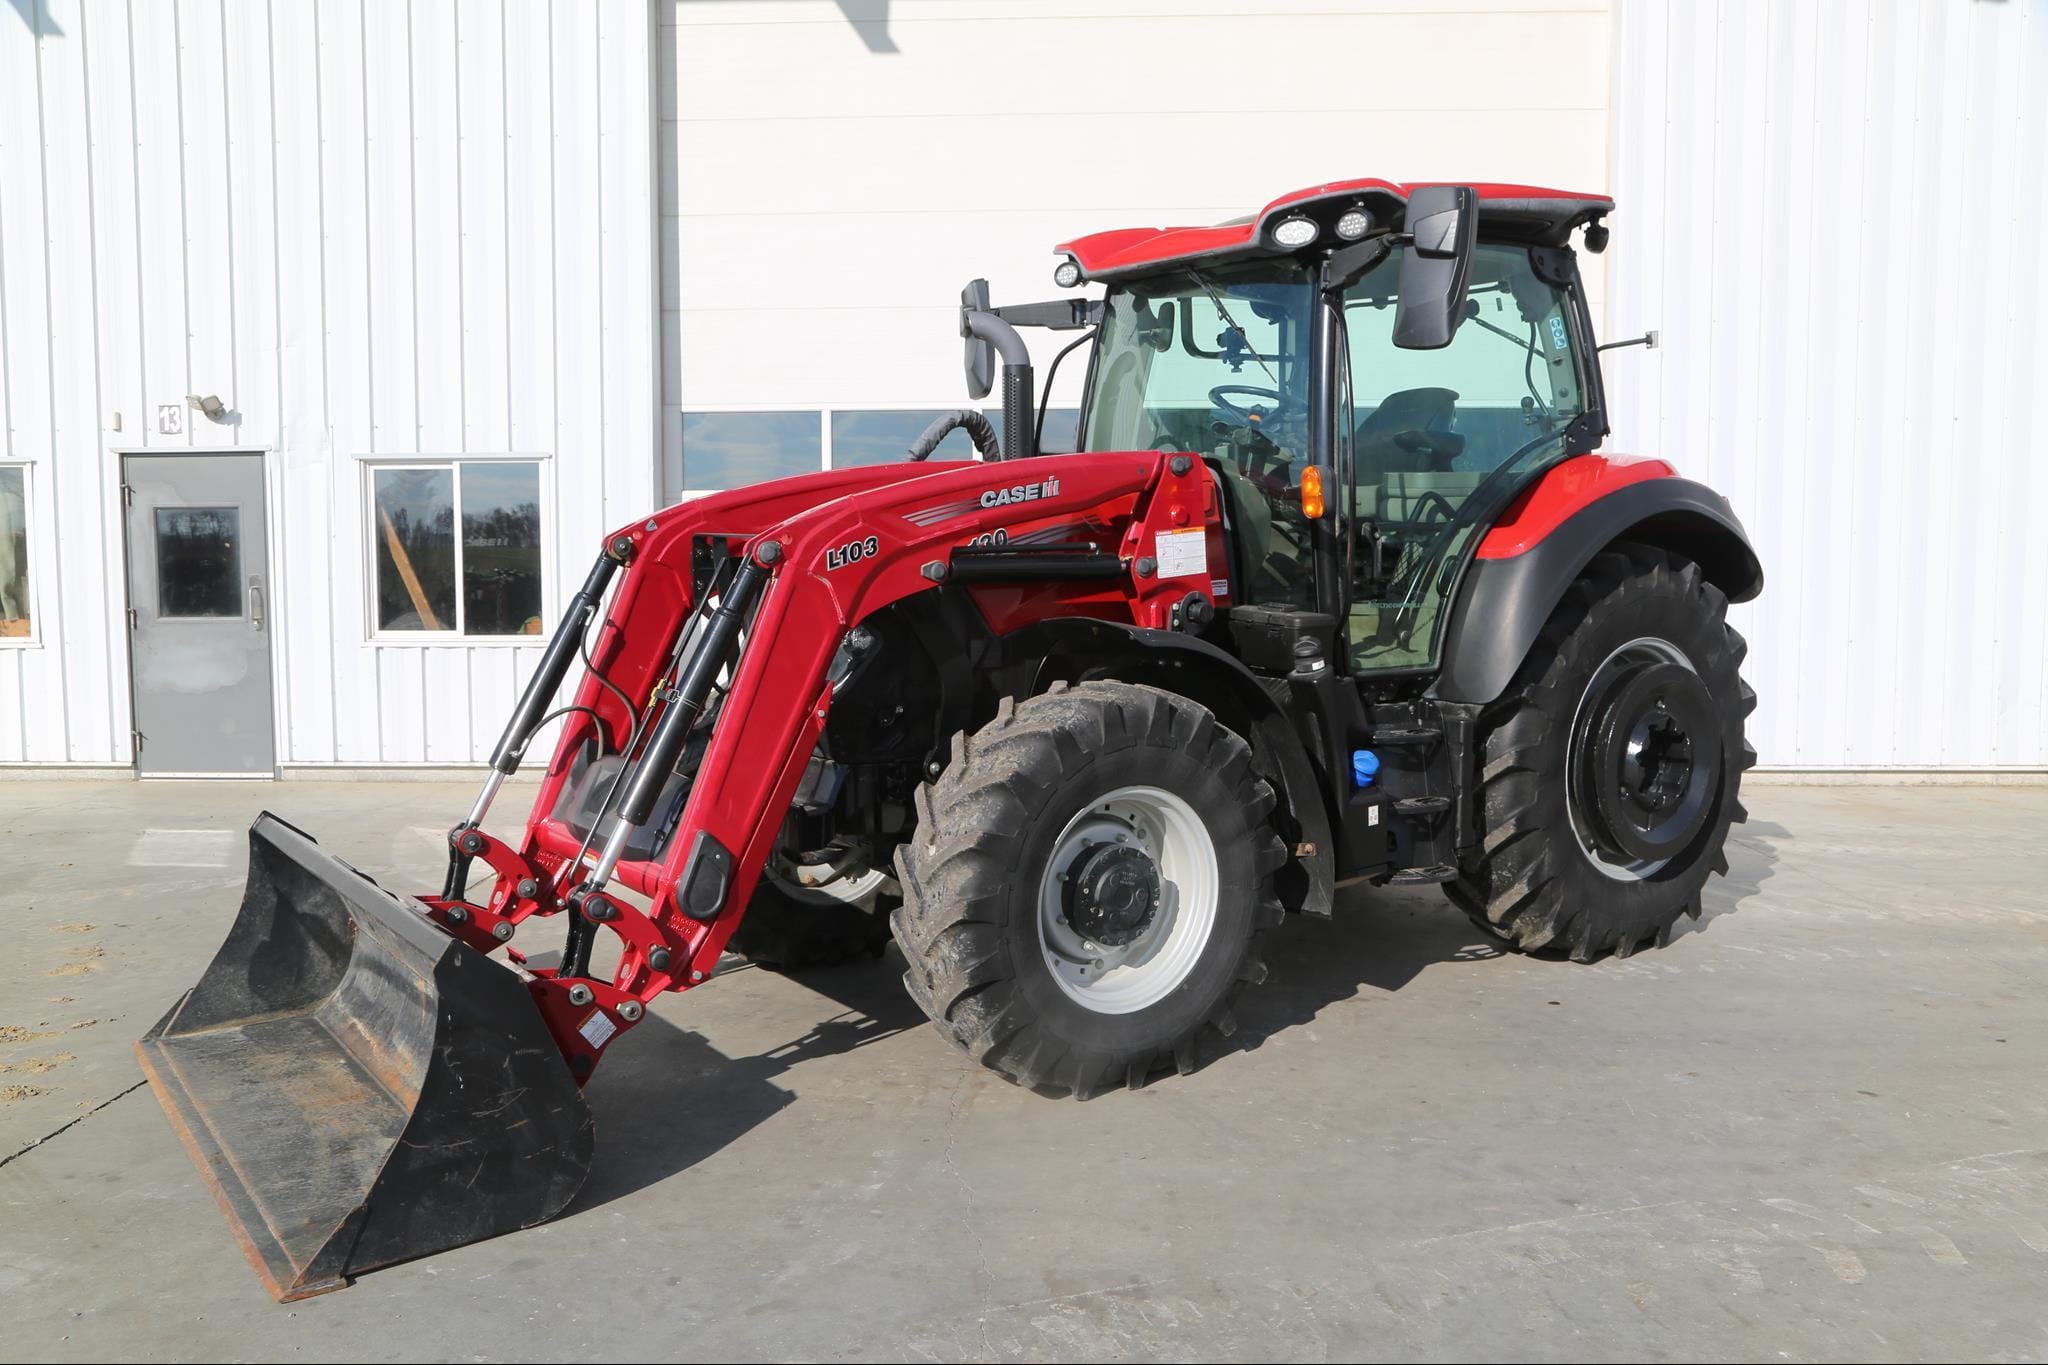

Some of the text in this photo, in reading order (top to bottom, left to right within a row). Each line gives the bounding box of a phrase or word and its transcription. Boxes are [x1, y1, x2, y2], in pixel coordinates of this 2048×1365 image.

[159, 405, 182, 433] 13
[980, 483, 1040, 508] CASE
[826, 535, 879, 571] L103
